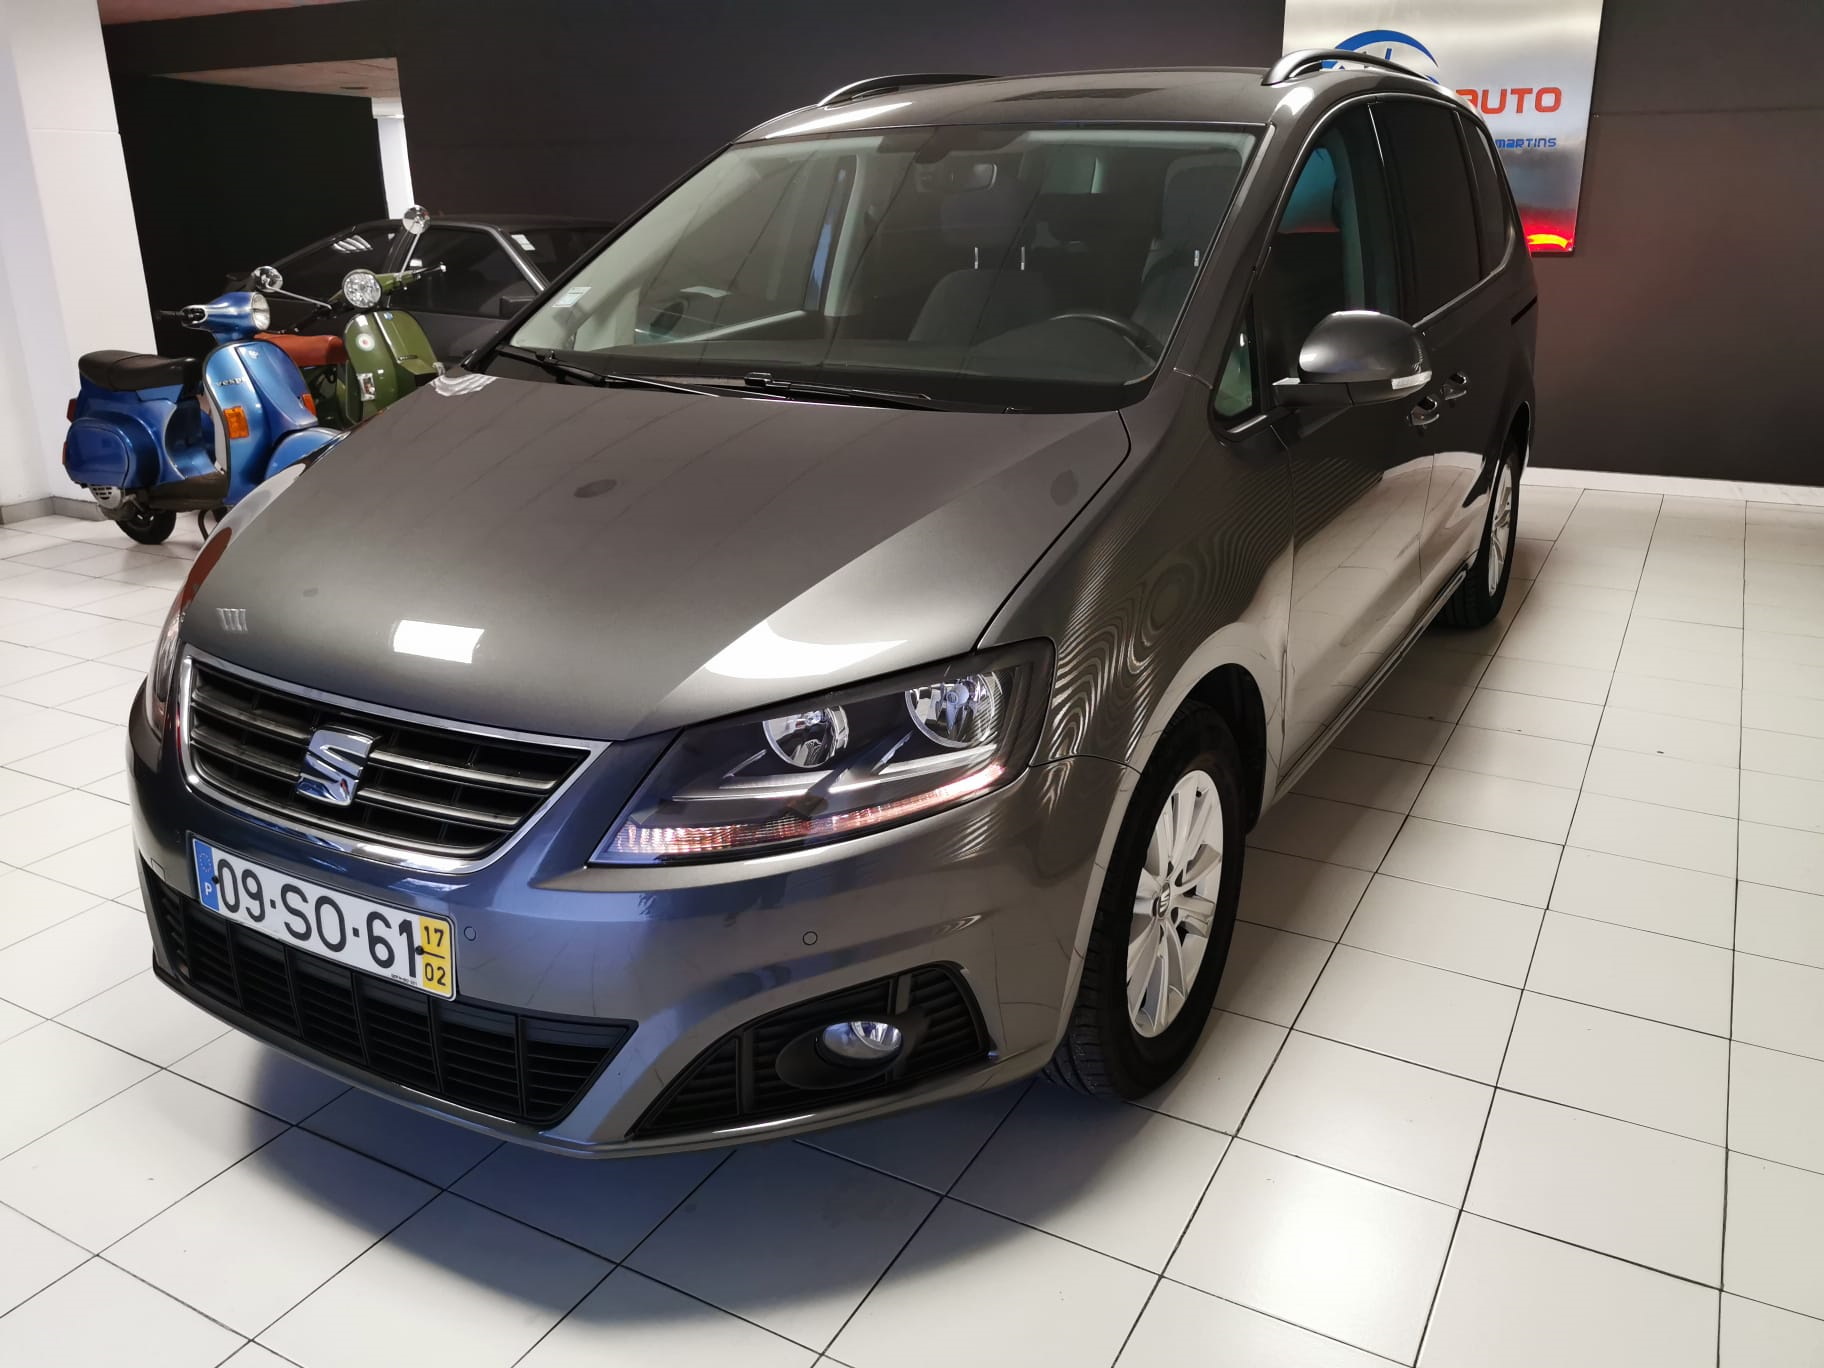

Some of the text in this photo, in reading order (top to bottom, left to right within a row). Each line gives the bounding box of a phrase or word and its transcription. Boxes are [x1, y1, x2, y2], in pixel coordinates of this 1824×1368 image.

[204, 881, 213, 896] P
[423, 924, 445, 948] 17
[424, 962, 447, 987] 02
